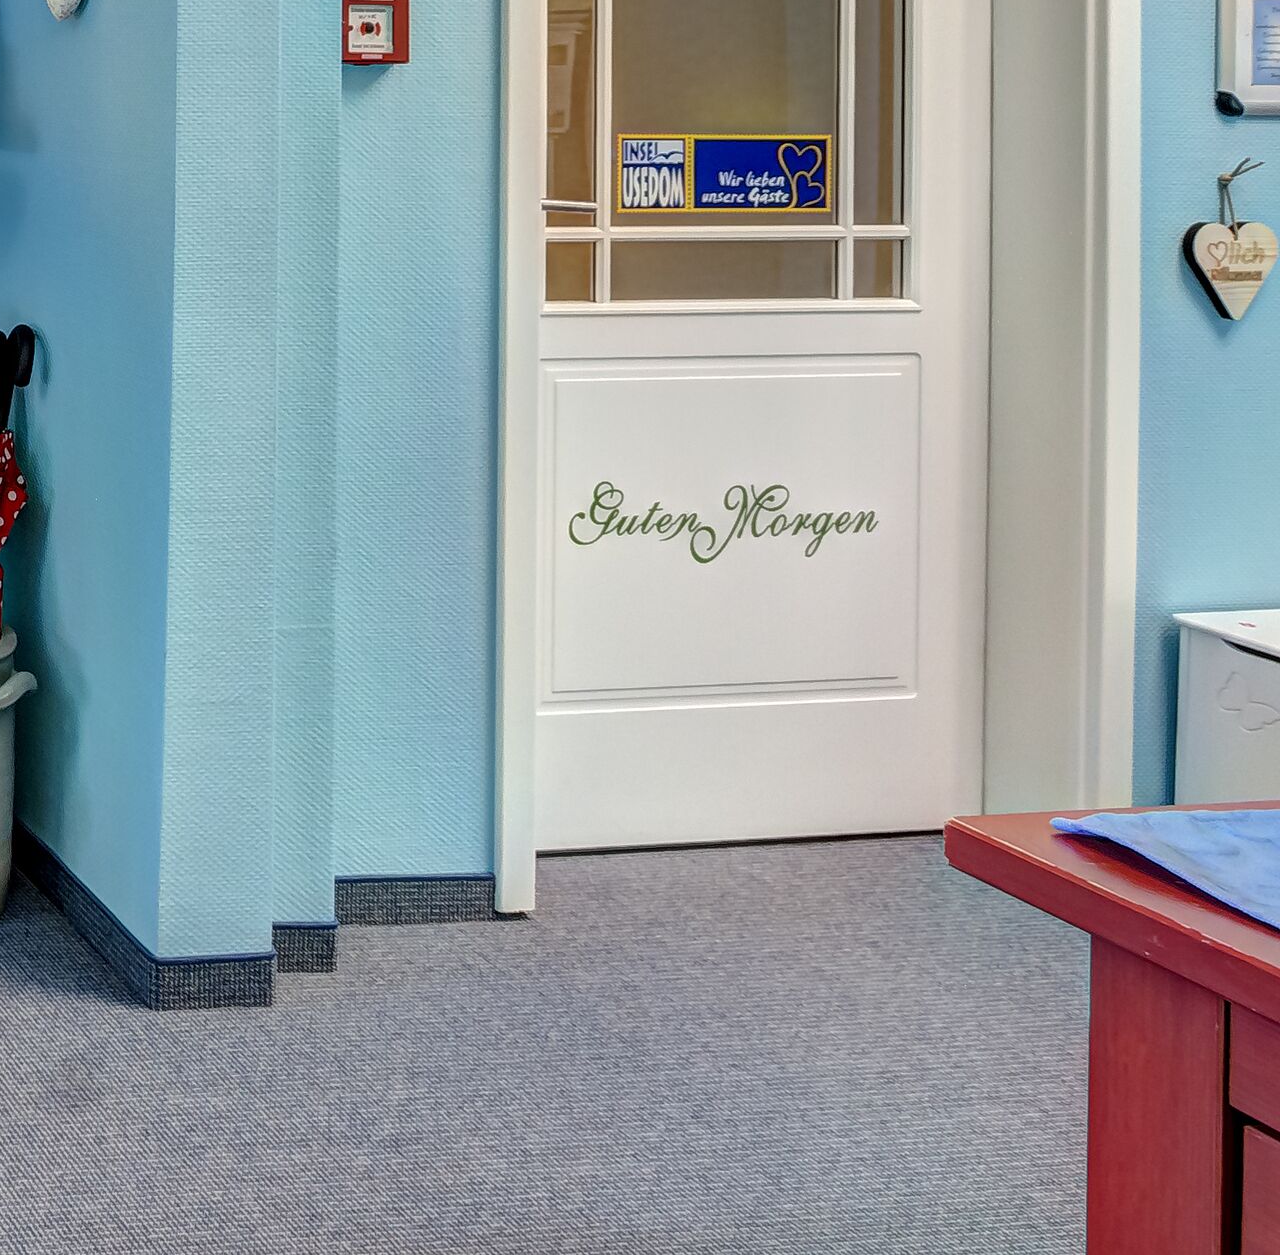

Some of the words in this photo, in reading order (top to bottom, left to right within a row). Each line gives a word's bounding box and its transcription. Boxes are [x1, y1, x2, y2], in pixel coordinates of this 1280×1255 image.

[623, 167, 684, 207] USEDOM
[718, 170, 744, 188] Wir
[745, 171, 785, 188] lieben
[701, 190, 745, 204] unsere
[748, 187, 790, 207] Gäste
[568, 481, 702, 546] Guten
[689, 484, 878, 564] Morgen
